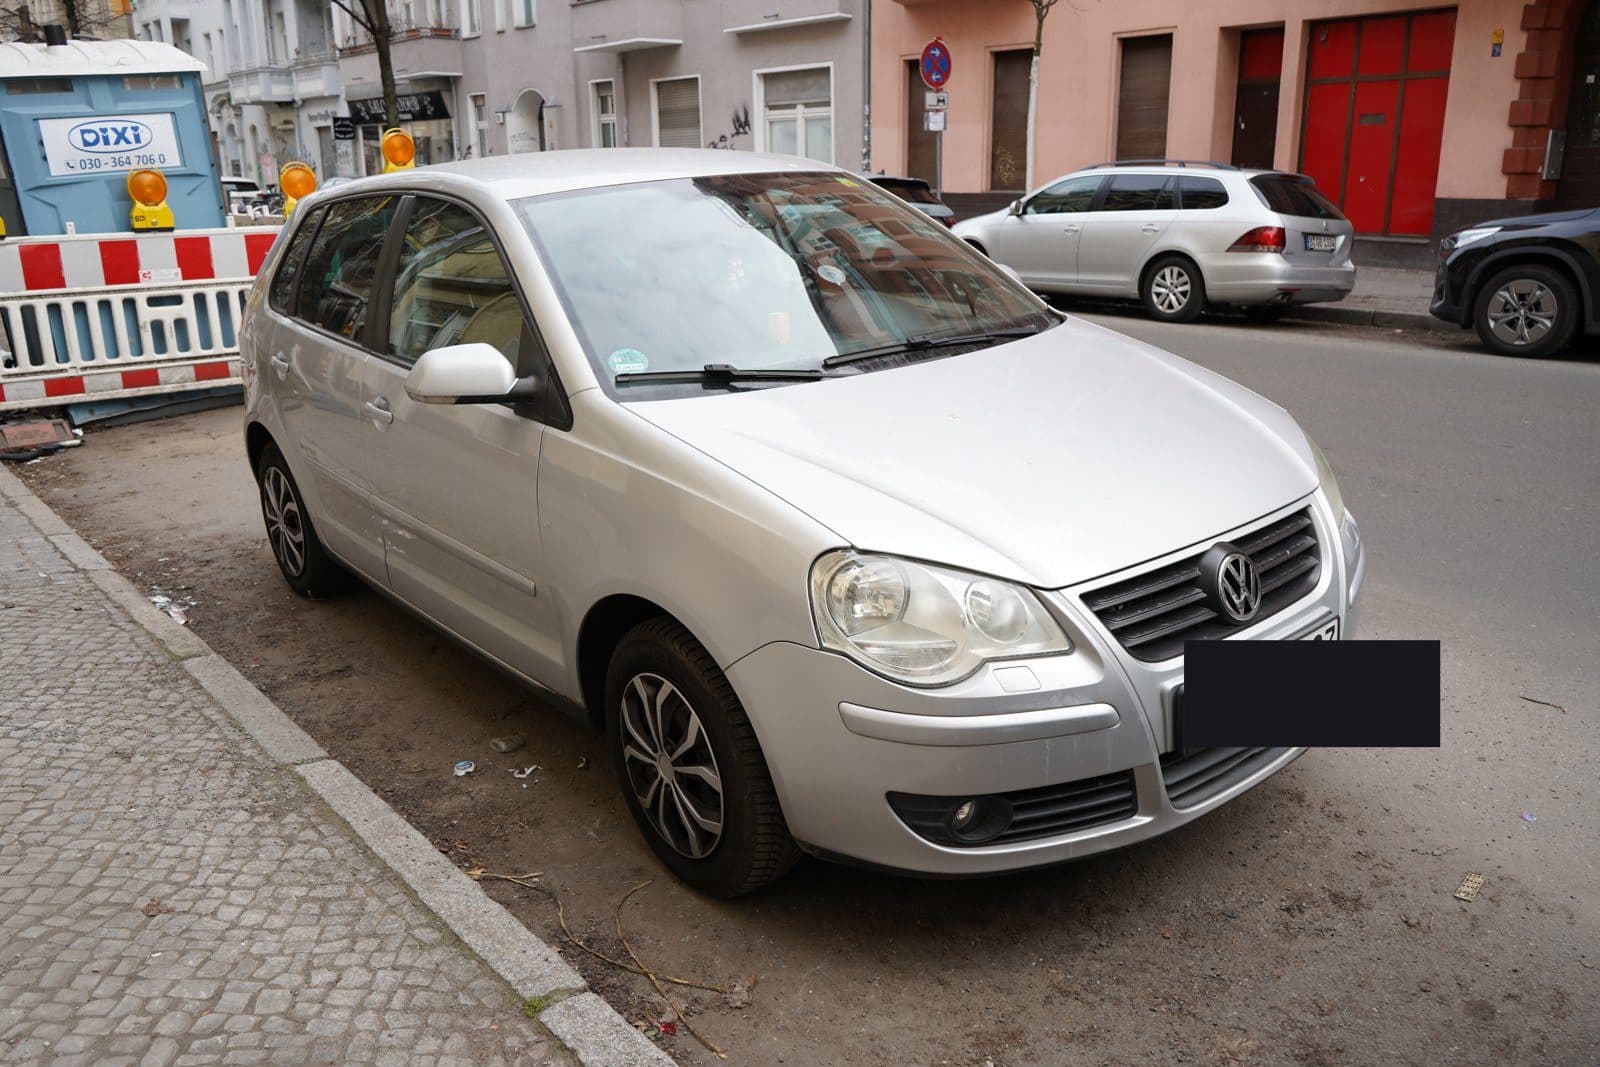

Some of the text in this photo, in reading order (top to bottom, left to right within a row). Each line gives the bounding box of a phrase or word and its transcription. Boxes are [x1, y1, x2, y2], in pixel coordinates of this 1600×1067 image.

[80, 158, 101, 170] 030
[111, 156, 131, 168] 364
[136, 154, 156, 165] 706
[158, 153, 166, 164] 0
